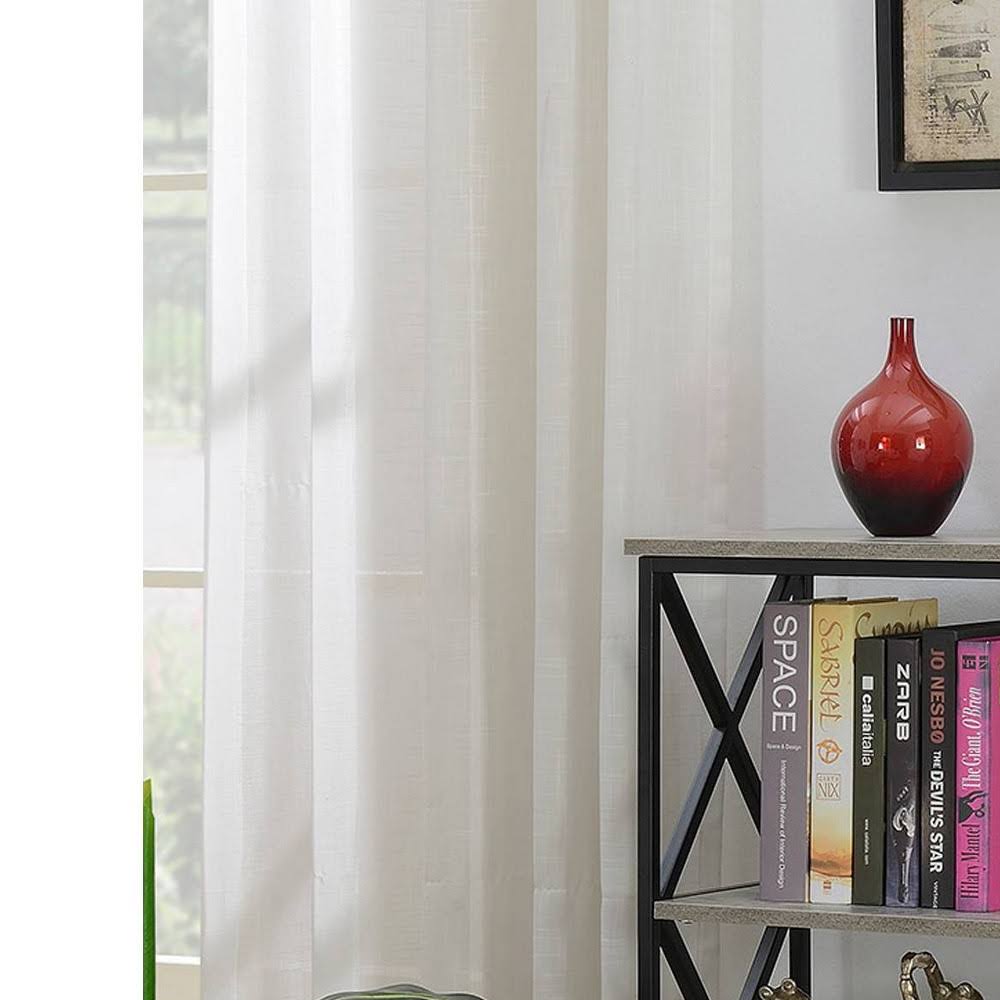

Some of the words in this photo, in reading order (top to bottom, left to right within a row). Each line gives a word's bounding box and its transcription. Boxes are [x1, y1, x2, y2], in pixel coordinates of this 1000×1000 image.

[772, 614, 798, 733] SPACE
[930, 648, 945, 670] JO
[896, 663, 911, 742] ZARB
[961, 687, 983, 729] O'Brien
[861, 694, 875, 766] caliaitalia
[932, 751, 943, 768] THE
[962, 768, 982, 789] The
[779, 760, 787, 802] International
[929, 770, 944, 828] DEVIL'S
[929, 835, 944, 873] STAR
[961, 824, 980, 861] Mantel
[960, 865, 986, 900] Hilary
